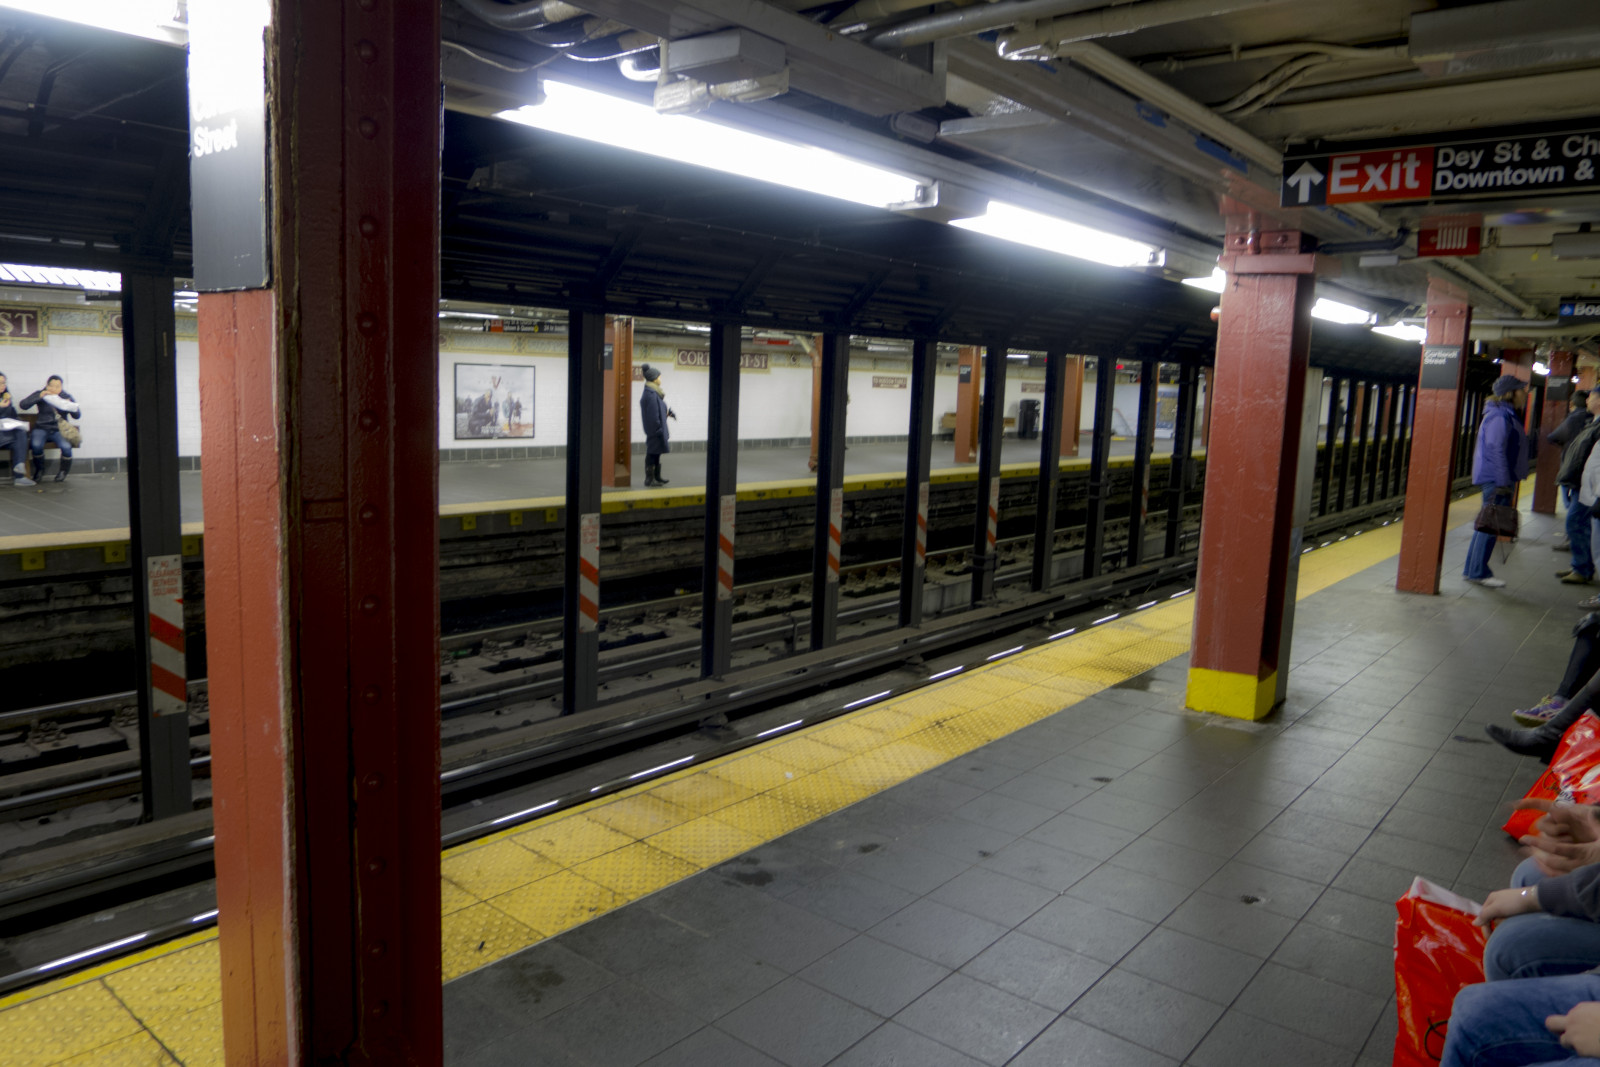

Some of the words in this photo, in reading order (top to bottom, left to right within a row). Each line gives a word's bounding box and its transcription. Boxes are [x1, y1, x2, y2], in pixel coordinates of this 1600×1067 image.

[1437, 147, 1484, 169] Dey
[1493, 141, 1522, 164] St
[1531, 139, 1551, 160] &
[1562, 134, 1600, 158] Ch
[1330, 152, 1421, 195] Exit
[1435, 166, 1565, 190] Downtown
[1574, 158, 1595, 181] &
[1424, 357, 1446, 365] Street
